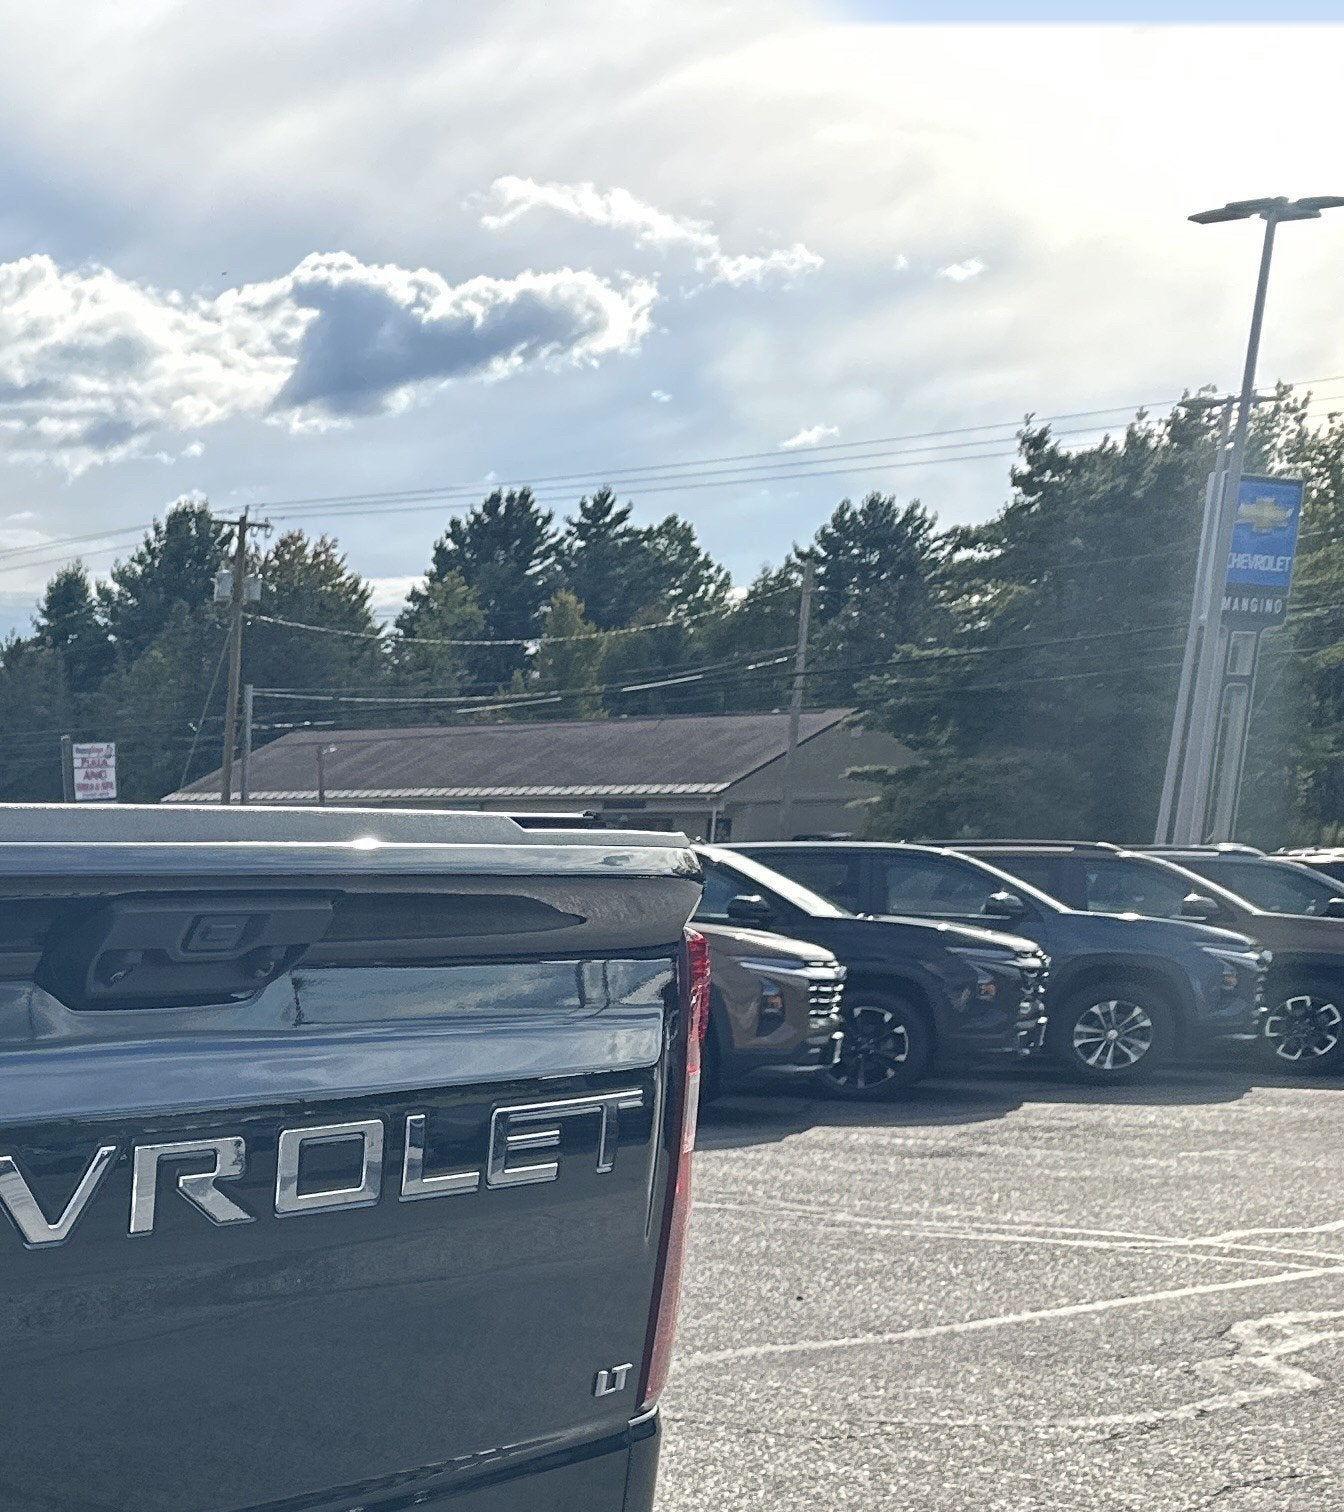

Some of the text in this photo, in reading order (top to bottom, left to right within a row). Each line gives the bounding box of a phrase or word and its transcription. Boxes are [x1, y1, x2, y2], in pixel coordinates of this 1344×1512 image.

[1227, 552, 1291, 572] CHEVROLET
[1221, 596, 1283, 614] MANGINO
[594, 1362, 633, 1397] LT
